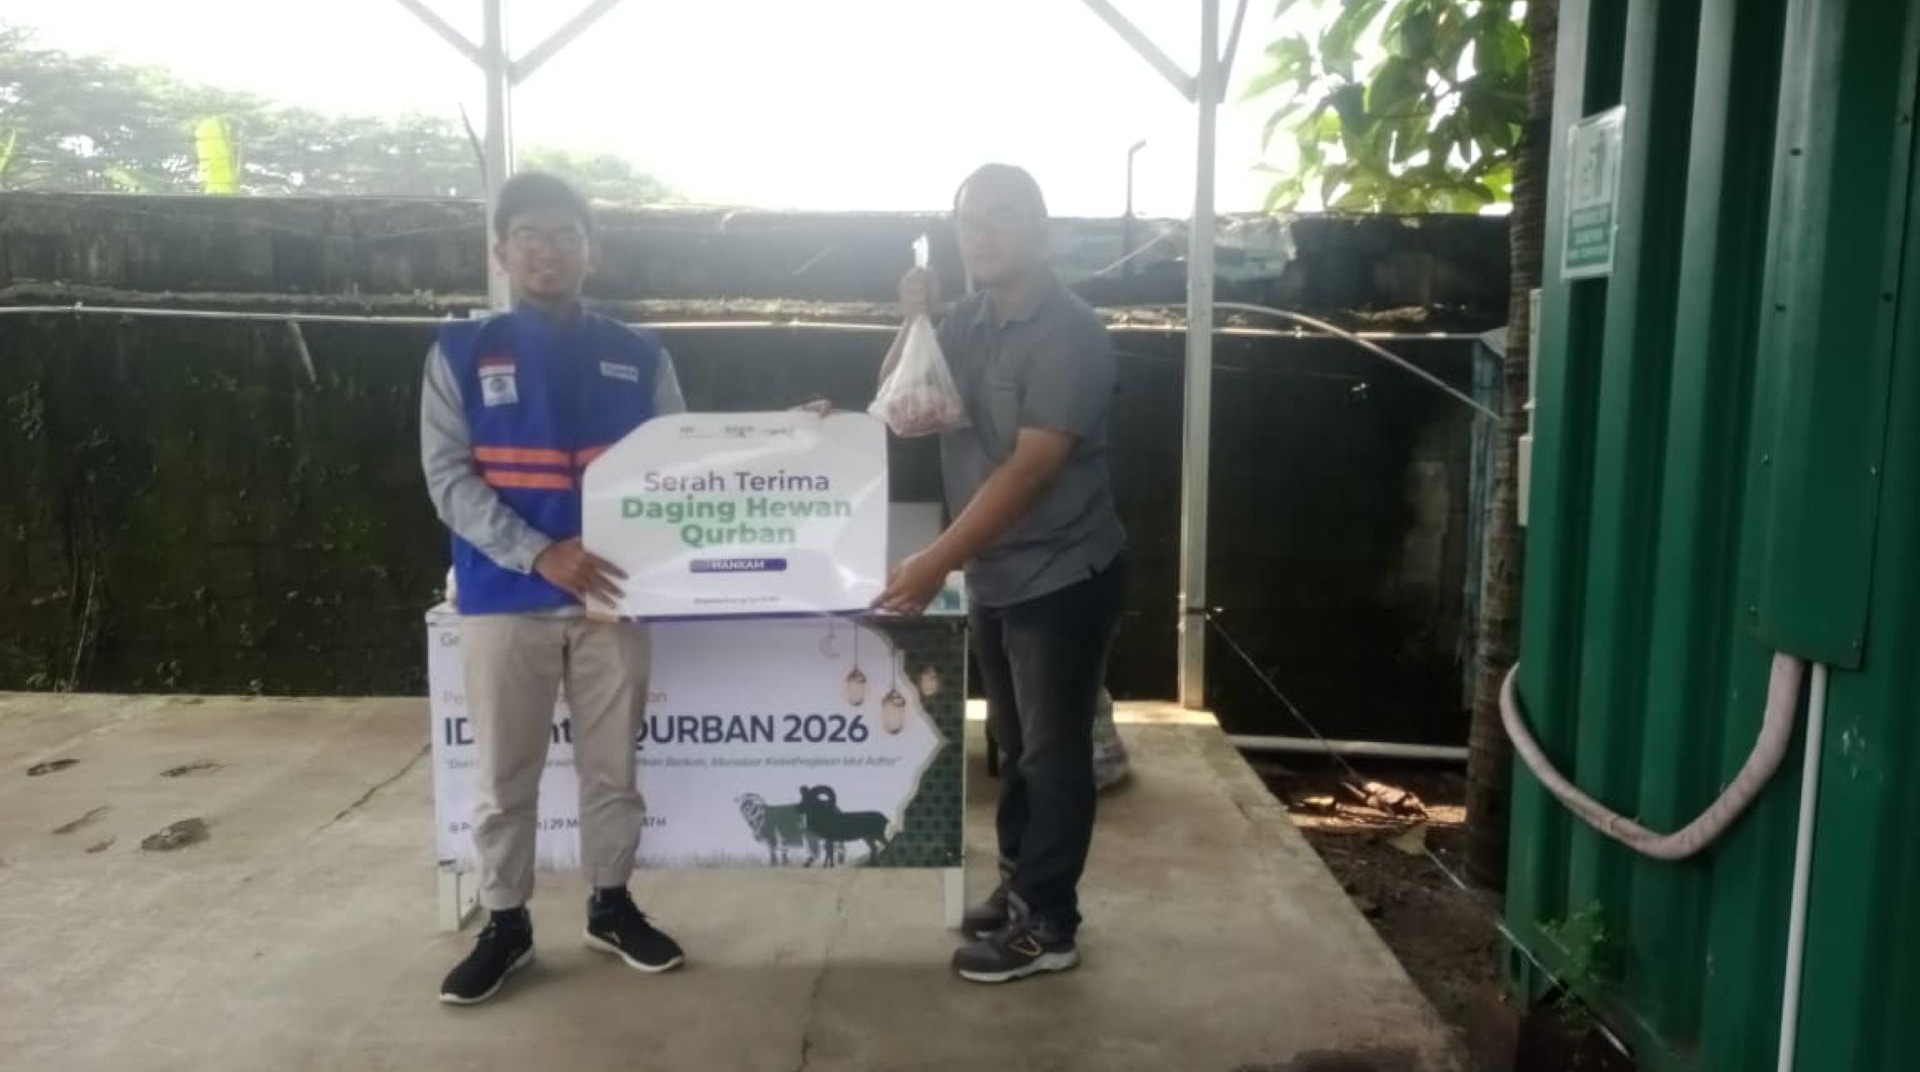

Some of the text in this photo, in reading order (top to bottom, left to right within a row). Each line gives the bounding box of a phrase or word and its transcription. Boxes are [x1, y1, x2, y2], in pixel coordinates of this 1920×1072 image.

[644, 470, 829, 492] Serah Terima
[621, 495, 851, 522] Daging Hewan
[681, 523, 797, 548] Qurban
[783, 714, 870, 744] 2026
